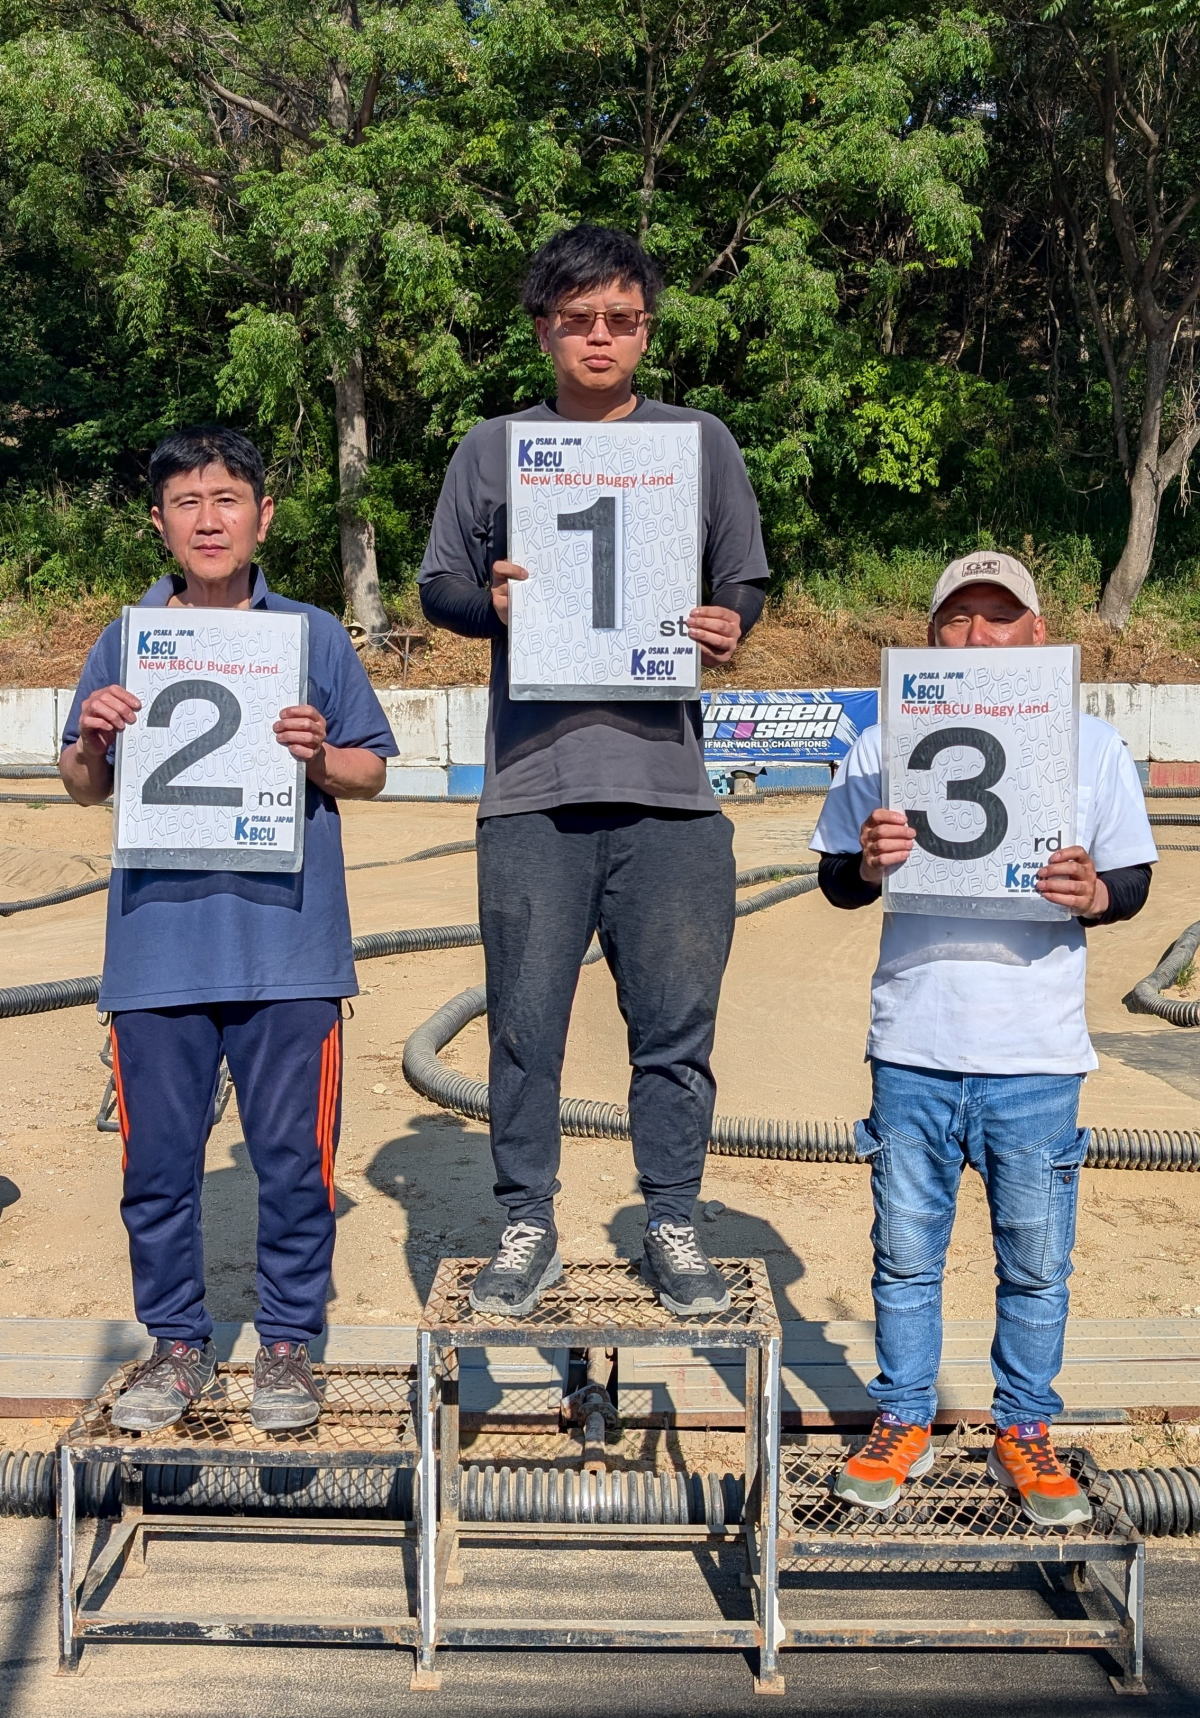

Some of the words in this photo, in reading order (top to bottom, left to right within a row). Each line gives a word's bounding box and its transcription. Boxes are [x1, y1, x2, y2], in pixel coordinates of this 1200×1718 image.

[518, 439, 563, 467] KBCU
[535, 438, 557, 446] OSAKA
[560, 438, 582, 446] JAPAN
[520, 473, 551, 485] New
[555, 473, 592, 486] KBCU
[597, 473, 637, 488] Buggy
[642, 472, 674, 486] Land
[557, 496, 616, 629] 1
[660, 616, 688, 637] st
[137, 631, 177, 655] KBCU
[673, 647, 693, 655] JAPAN
[139, 660, 165, 670] New
[169, 660, 203, 671] KBCU
[208, 661, 245, 674] Buggy
[249, 663, 278, 674] Land
[631, 648, 674, 675] KBCU
[902, 674, 945, 700] KBCU
[901, 703, 930, 714] New
[934, 703, 970, 715] KBCU
[975, 703, 1014, 717] Buggy
[1018, 702, 1049, 714] Land
[142, 680, 243, 807] 2
[259, 786, 293, 807] nd
[704, 741, 734, 749] IFMAR
[737, 740, 768, 749] WORLD
[771, 740, 828, 749] CHAMPIONS
[905, 727, 1009, 861] 3
[1034, 830, 1062, 852] rd
[234, 816, 275, 841] KBCU
